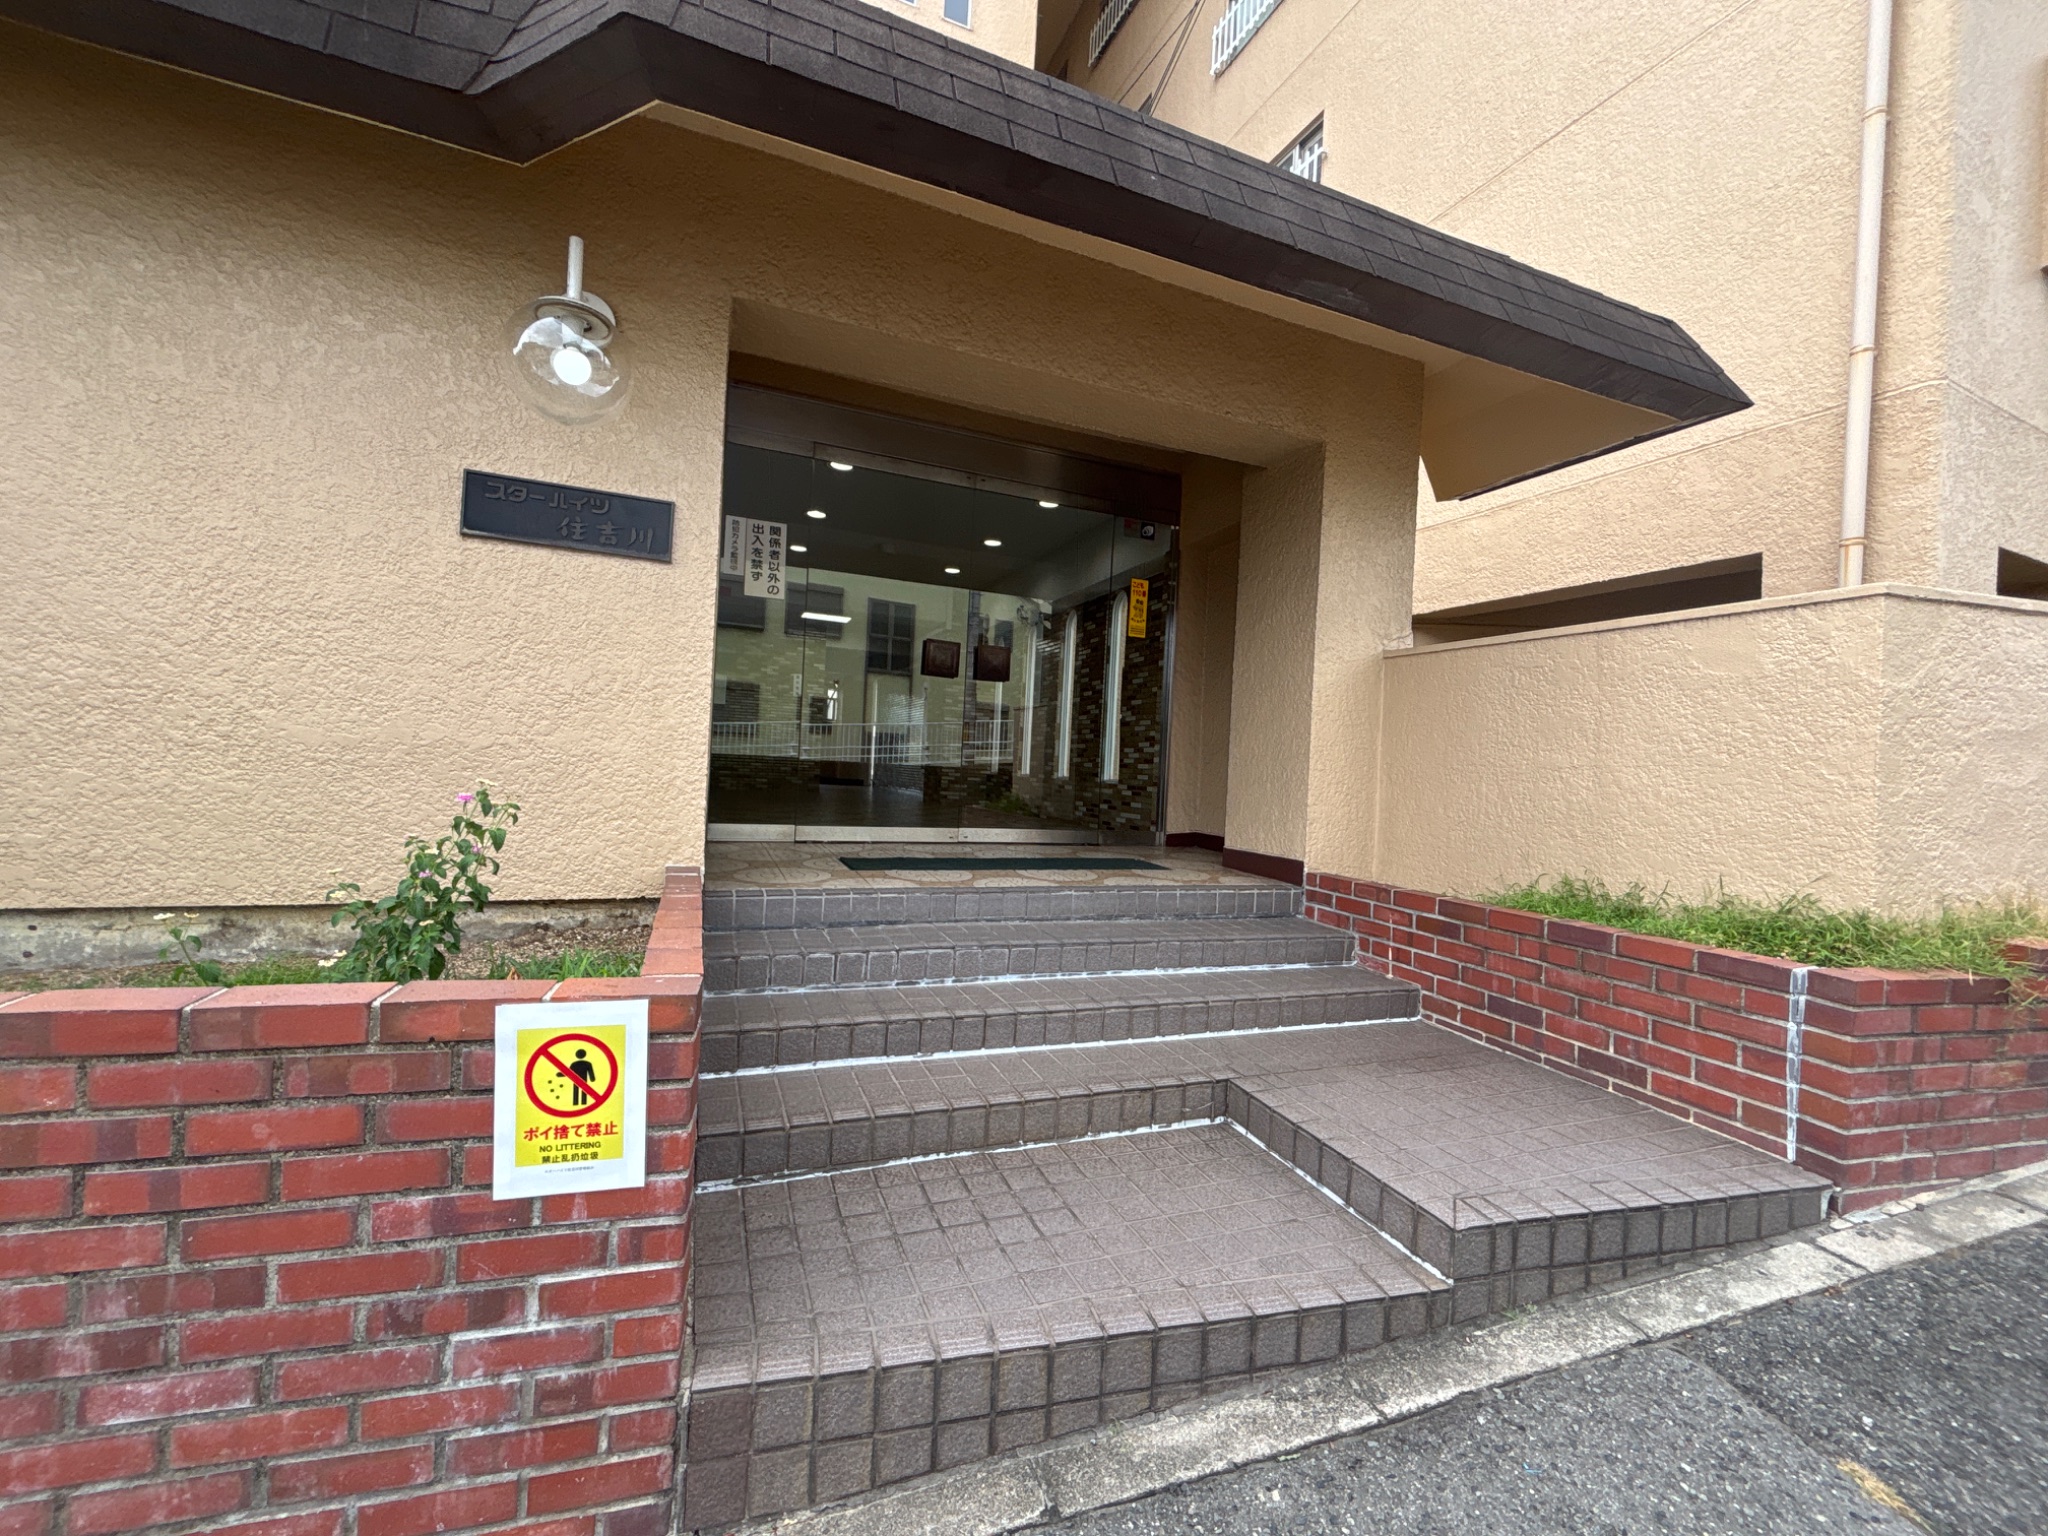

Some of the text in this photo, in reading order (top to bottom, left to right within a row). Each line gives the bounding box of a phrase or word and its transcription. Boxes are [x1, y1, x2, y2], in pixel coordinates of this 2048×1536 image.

[484, 481, 610, 514] スターハイツ
[557, 516, 654, 552] 住吉川
[750, 523, 764, 581] 出入を禁ず
[767, 525, 782, 595] 関係者以外の
[523, 1121, 618, 1141] ポイ捨て禁止
[539, 1141, 602, 1153] NO LITTERING
[541, 1151, 599, 1164] 禁止乱扔垃圾
